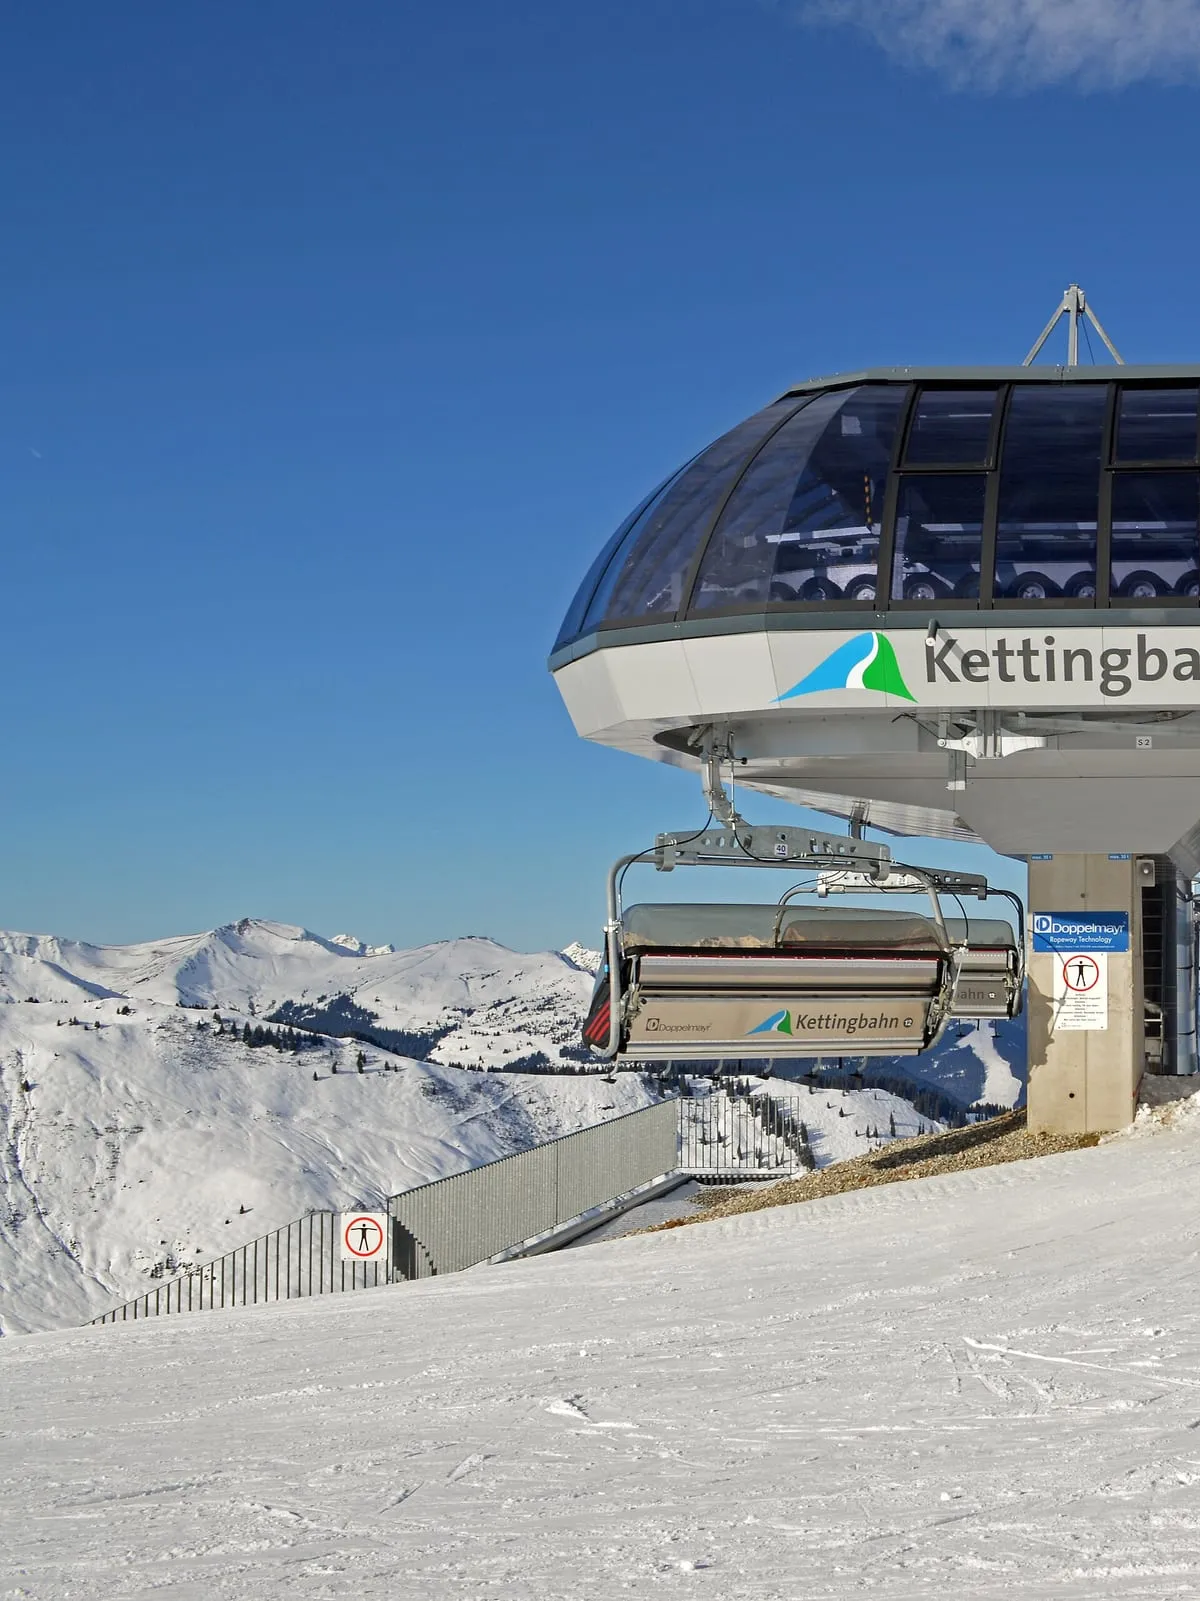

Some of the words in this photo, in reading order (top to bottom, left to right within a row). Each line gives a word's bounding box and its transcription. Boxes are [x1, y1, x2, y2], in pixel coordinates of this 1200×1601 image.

[776, 845, 786, 853] 40
[1052, 923, 1125, 935] Doppelmayr
[1049, 936, 1077, 944] Ropeway
[1078, 936, 1112, 944] Technology
[659, 1023, 711, 1033] Doppelmayr
[796, 1013, 899, 1034] Kettingbahn
